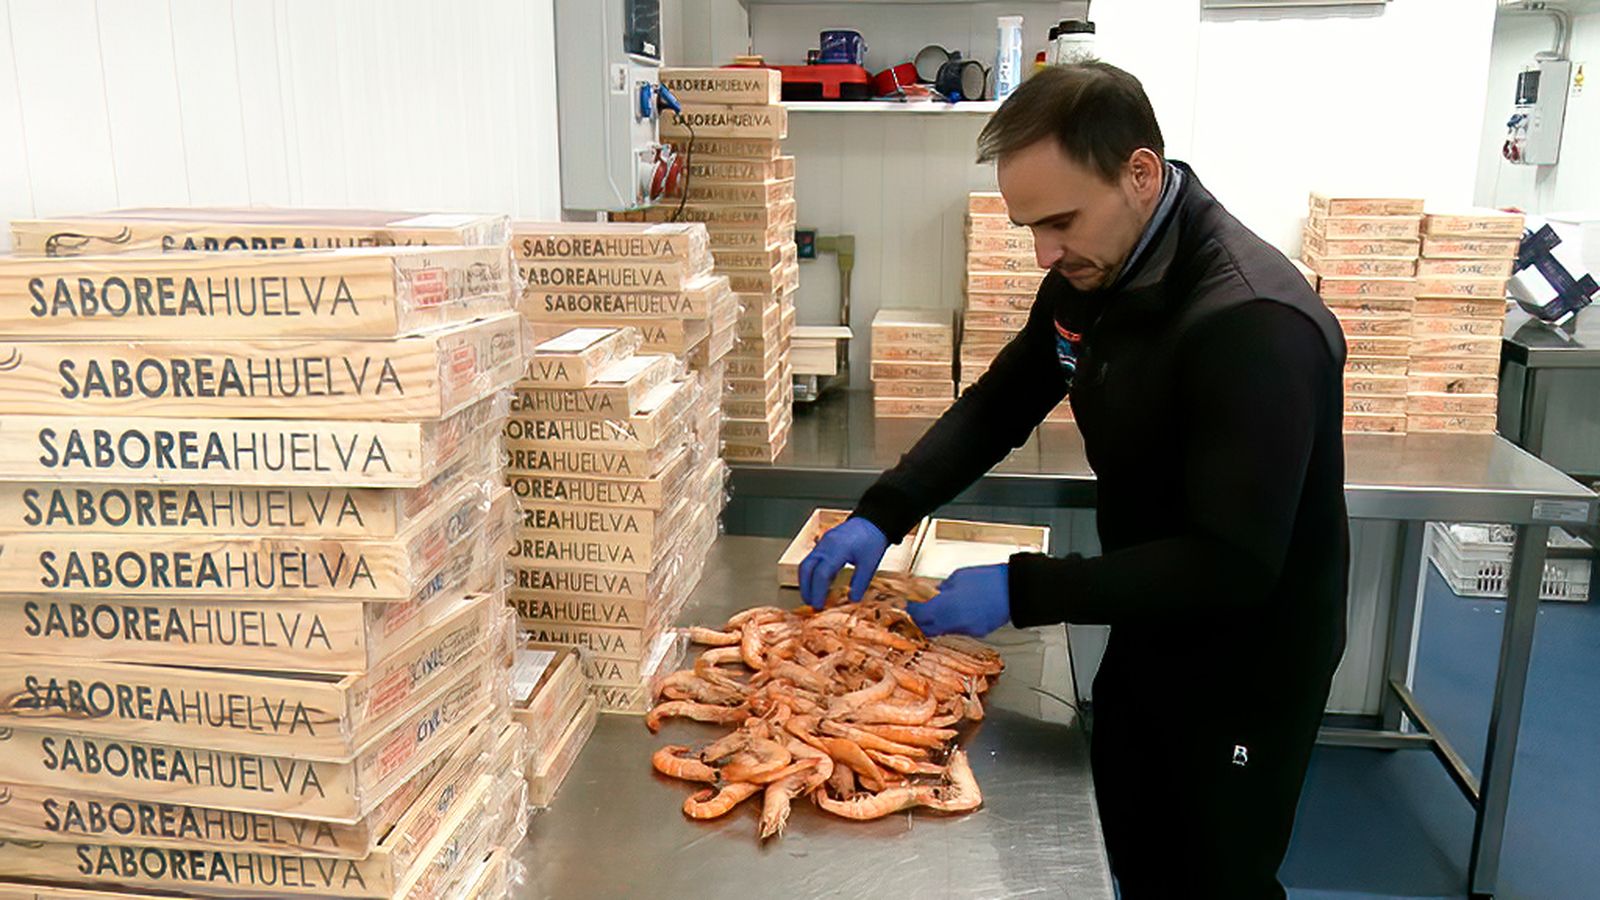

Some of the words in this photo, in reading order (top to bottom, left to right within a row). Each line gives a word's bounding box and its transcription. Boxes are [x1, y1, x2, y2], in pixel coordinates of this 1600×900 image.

[667, 78, 761, 92] ABOREAHUELVA
[523, 238, 675, 257] SABOREAHUELVA
[29, 276, 359, 317] SABOREAHUELVA
[518, 267, 667, 286] SABOREAHUELVA
[545, 295, 693, 313] SABOREAHUELVA
[59, 357, 404, 399] SABOREAHUELVA
[38, 427, 392, 472] SABOREAHUELVA
[22, 488, 364, 528] SABOREAHUELVA
[523, 509, 639, 533] REAHUELVA
[39, 550, 377, 589] SABOREAHUELVA
[24, 600, 333, 650] SABOREAHUELVA
[24, 675, 316, 736] SABOREAHUELVA
[42, 736, 325, 798] SABOREAHUELVA
[43, 798, 340, 847] SABOREAHUELVA
[77, 843, 367, 890] SABOREAHUELVA
